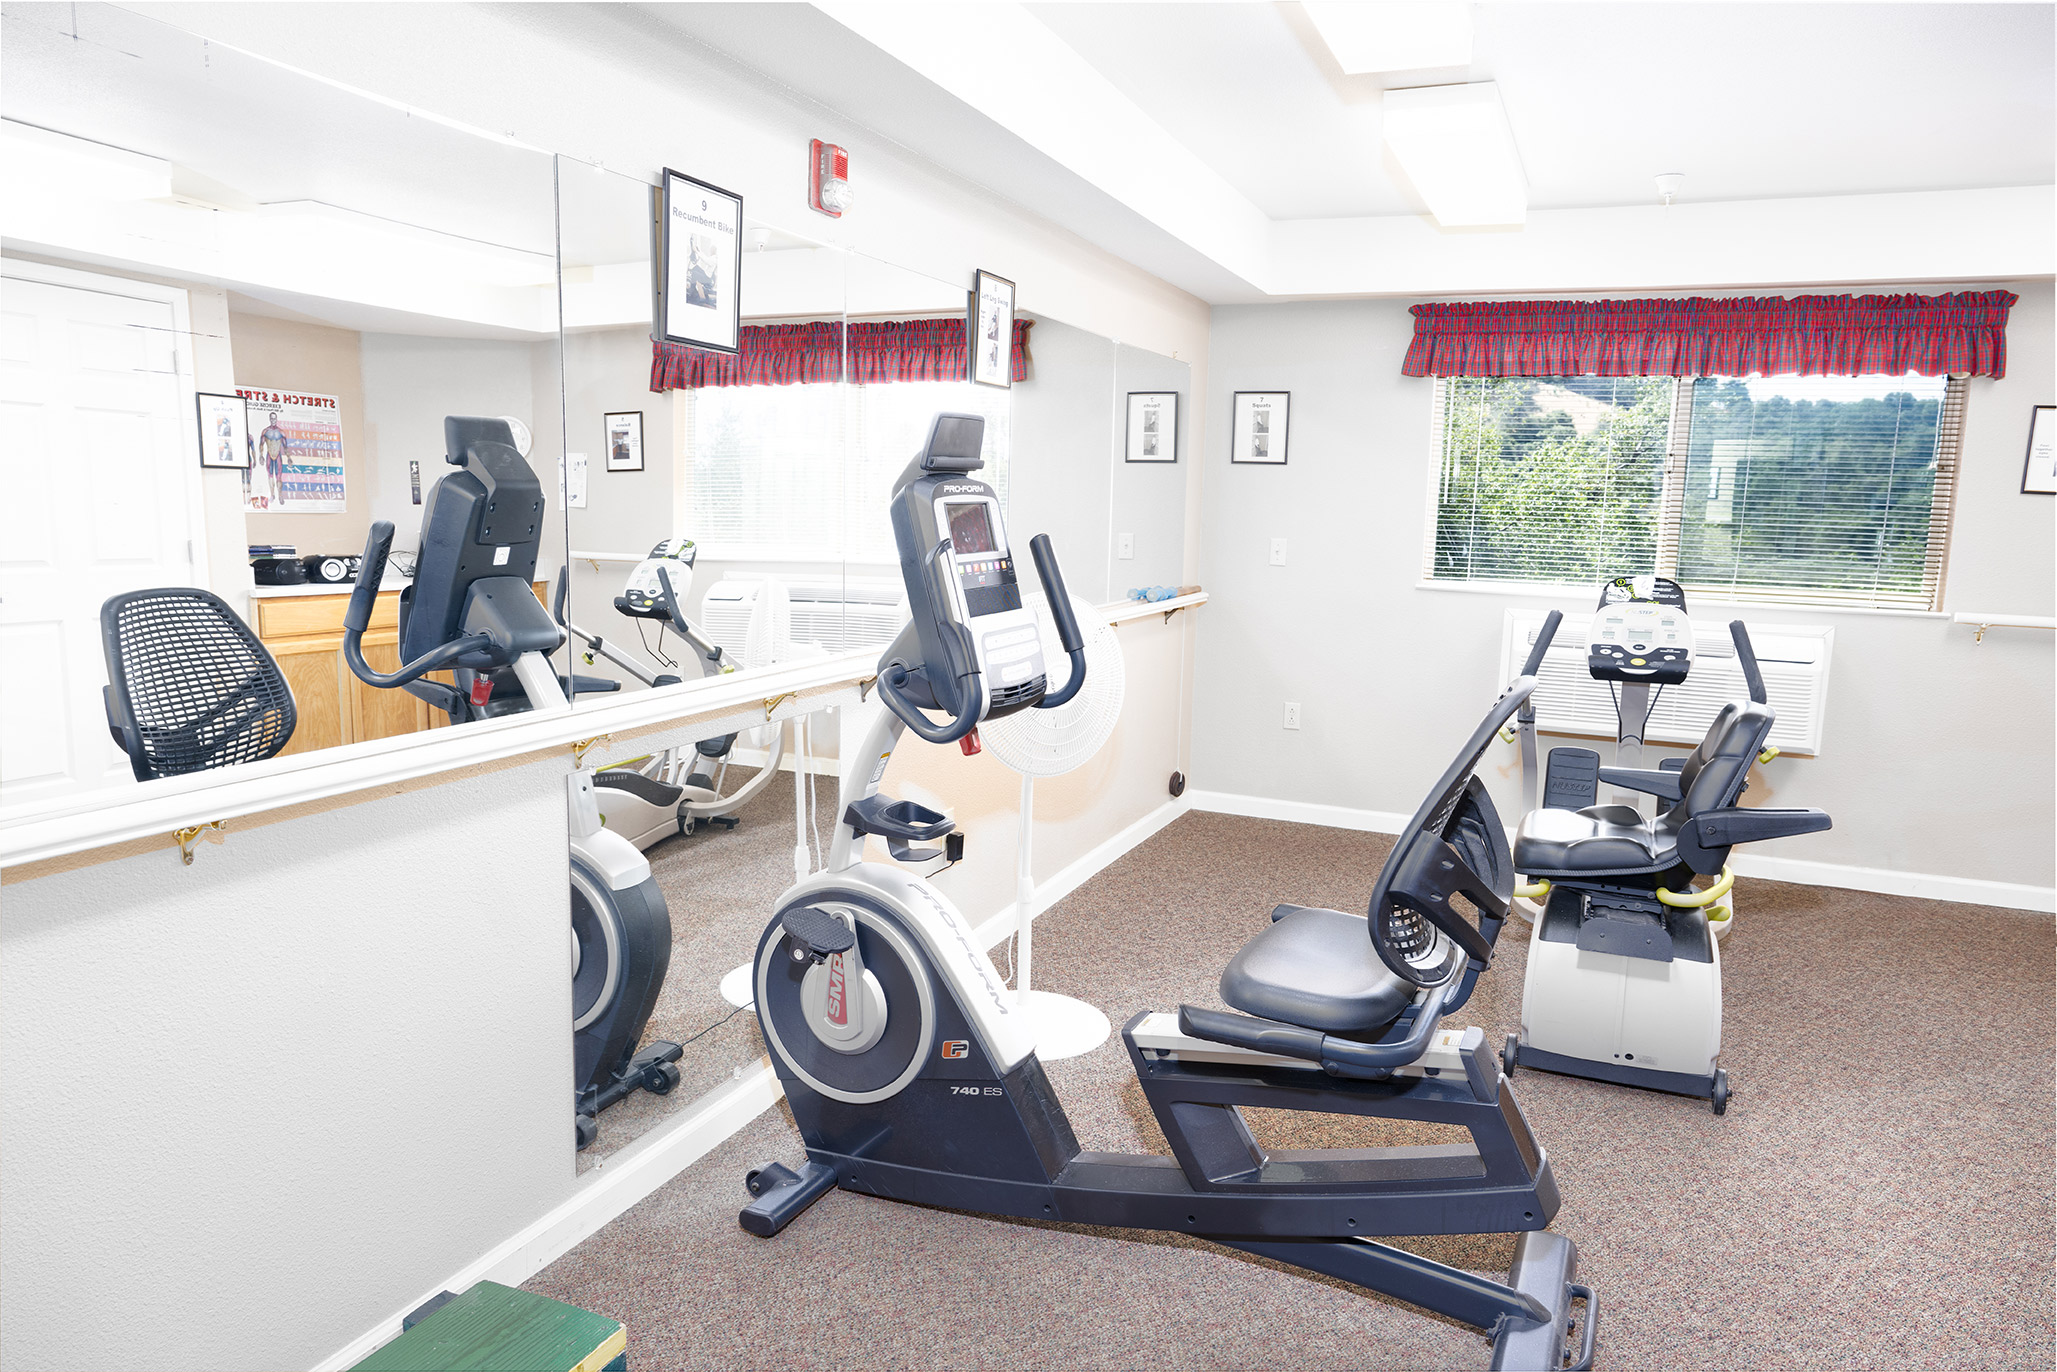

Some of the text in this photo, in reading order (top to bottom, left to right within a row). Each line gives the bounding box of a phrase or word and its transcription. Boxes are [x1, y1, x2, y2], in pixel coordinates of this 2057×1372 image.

[701, 200, 707, 212] 9
[672, 206, 734, 235] Recumbent Bike
[943, 485, 984, 493] PRO-FORM
[907, 883, 1008, 1015] PRO-FORM
[950, 1086, 1003, 1096] 740 ES
